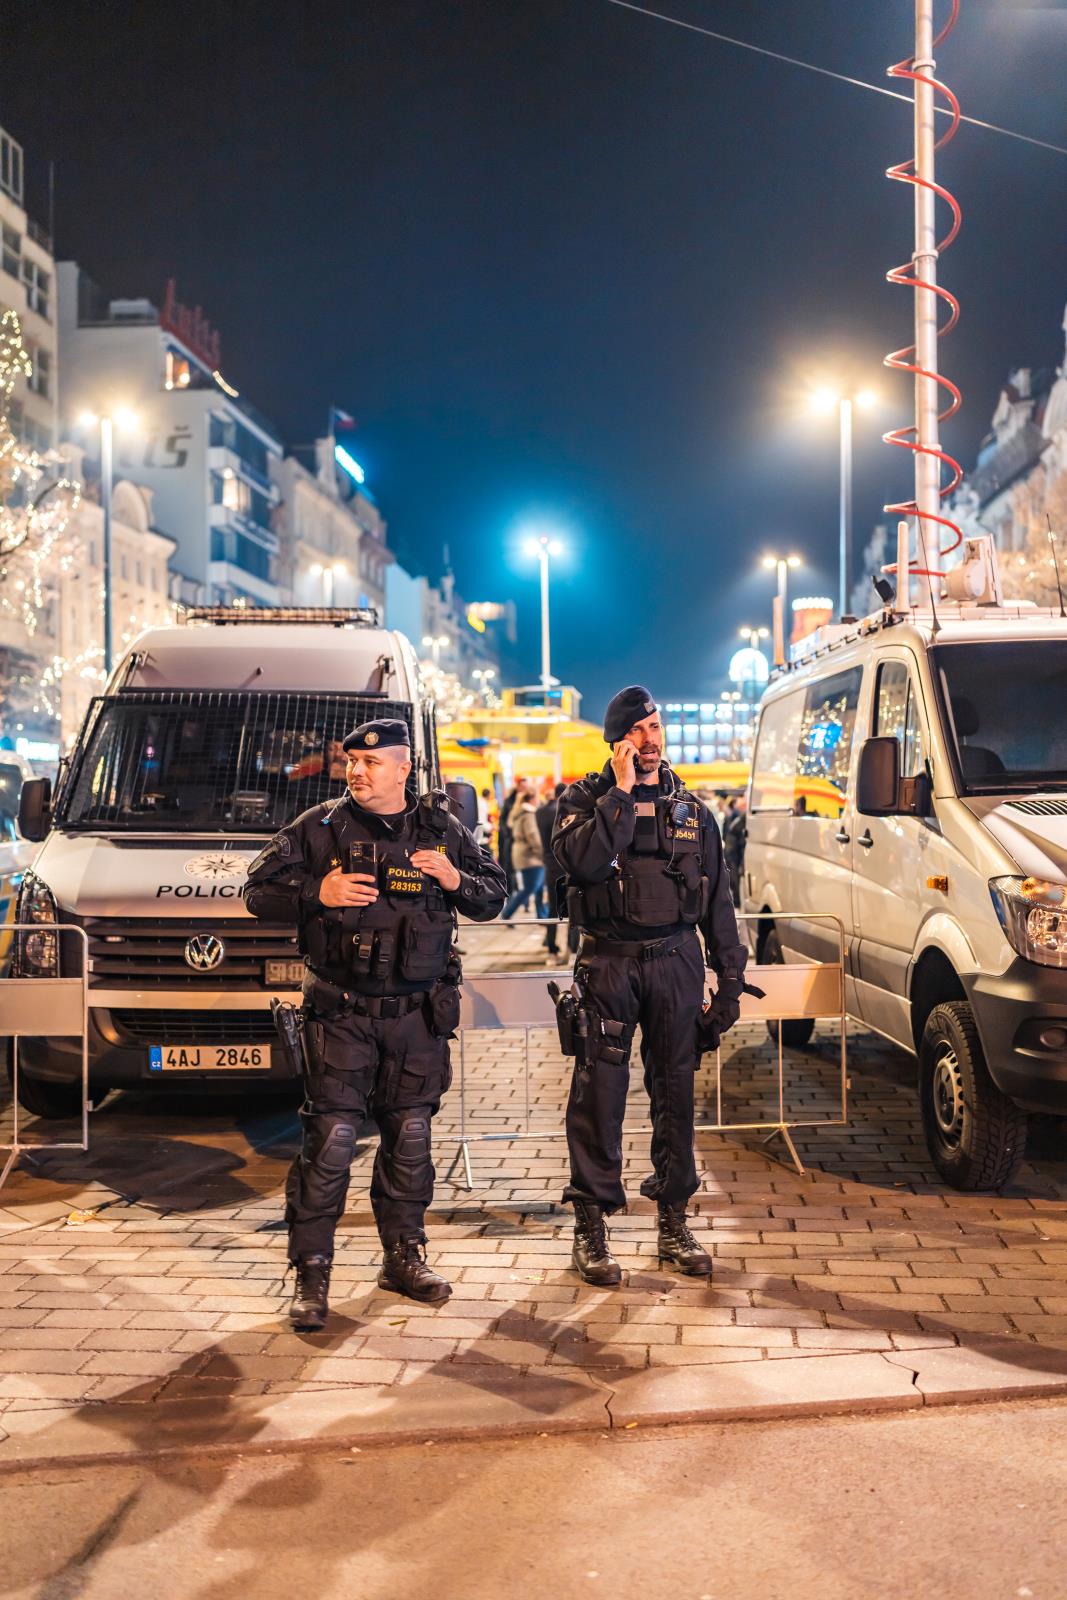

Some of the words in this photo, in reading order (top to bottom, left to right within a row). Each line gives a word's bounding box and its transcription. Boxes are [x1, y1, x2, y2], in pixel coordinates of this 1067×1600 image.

[156, 885, 245, 898] POLICI
[390, 881, 422, 892] 283153
[166, 1049, 201, 1067] 4AJ
[216, 1048, 262, 1066] 2846
